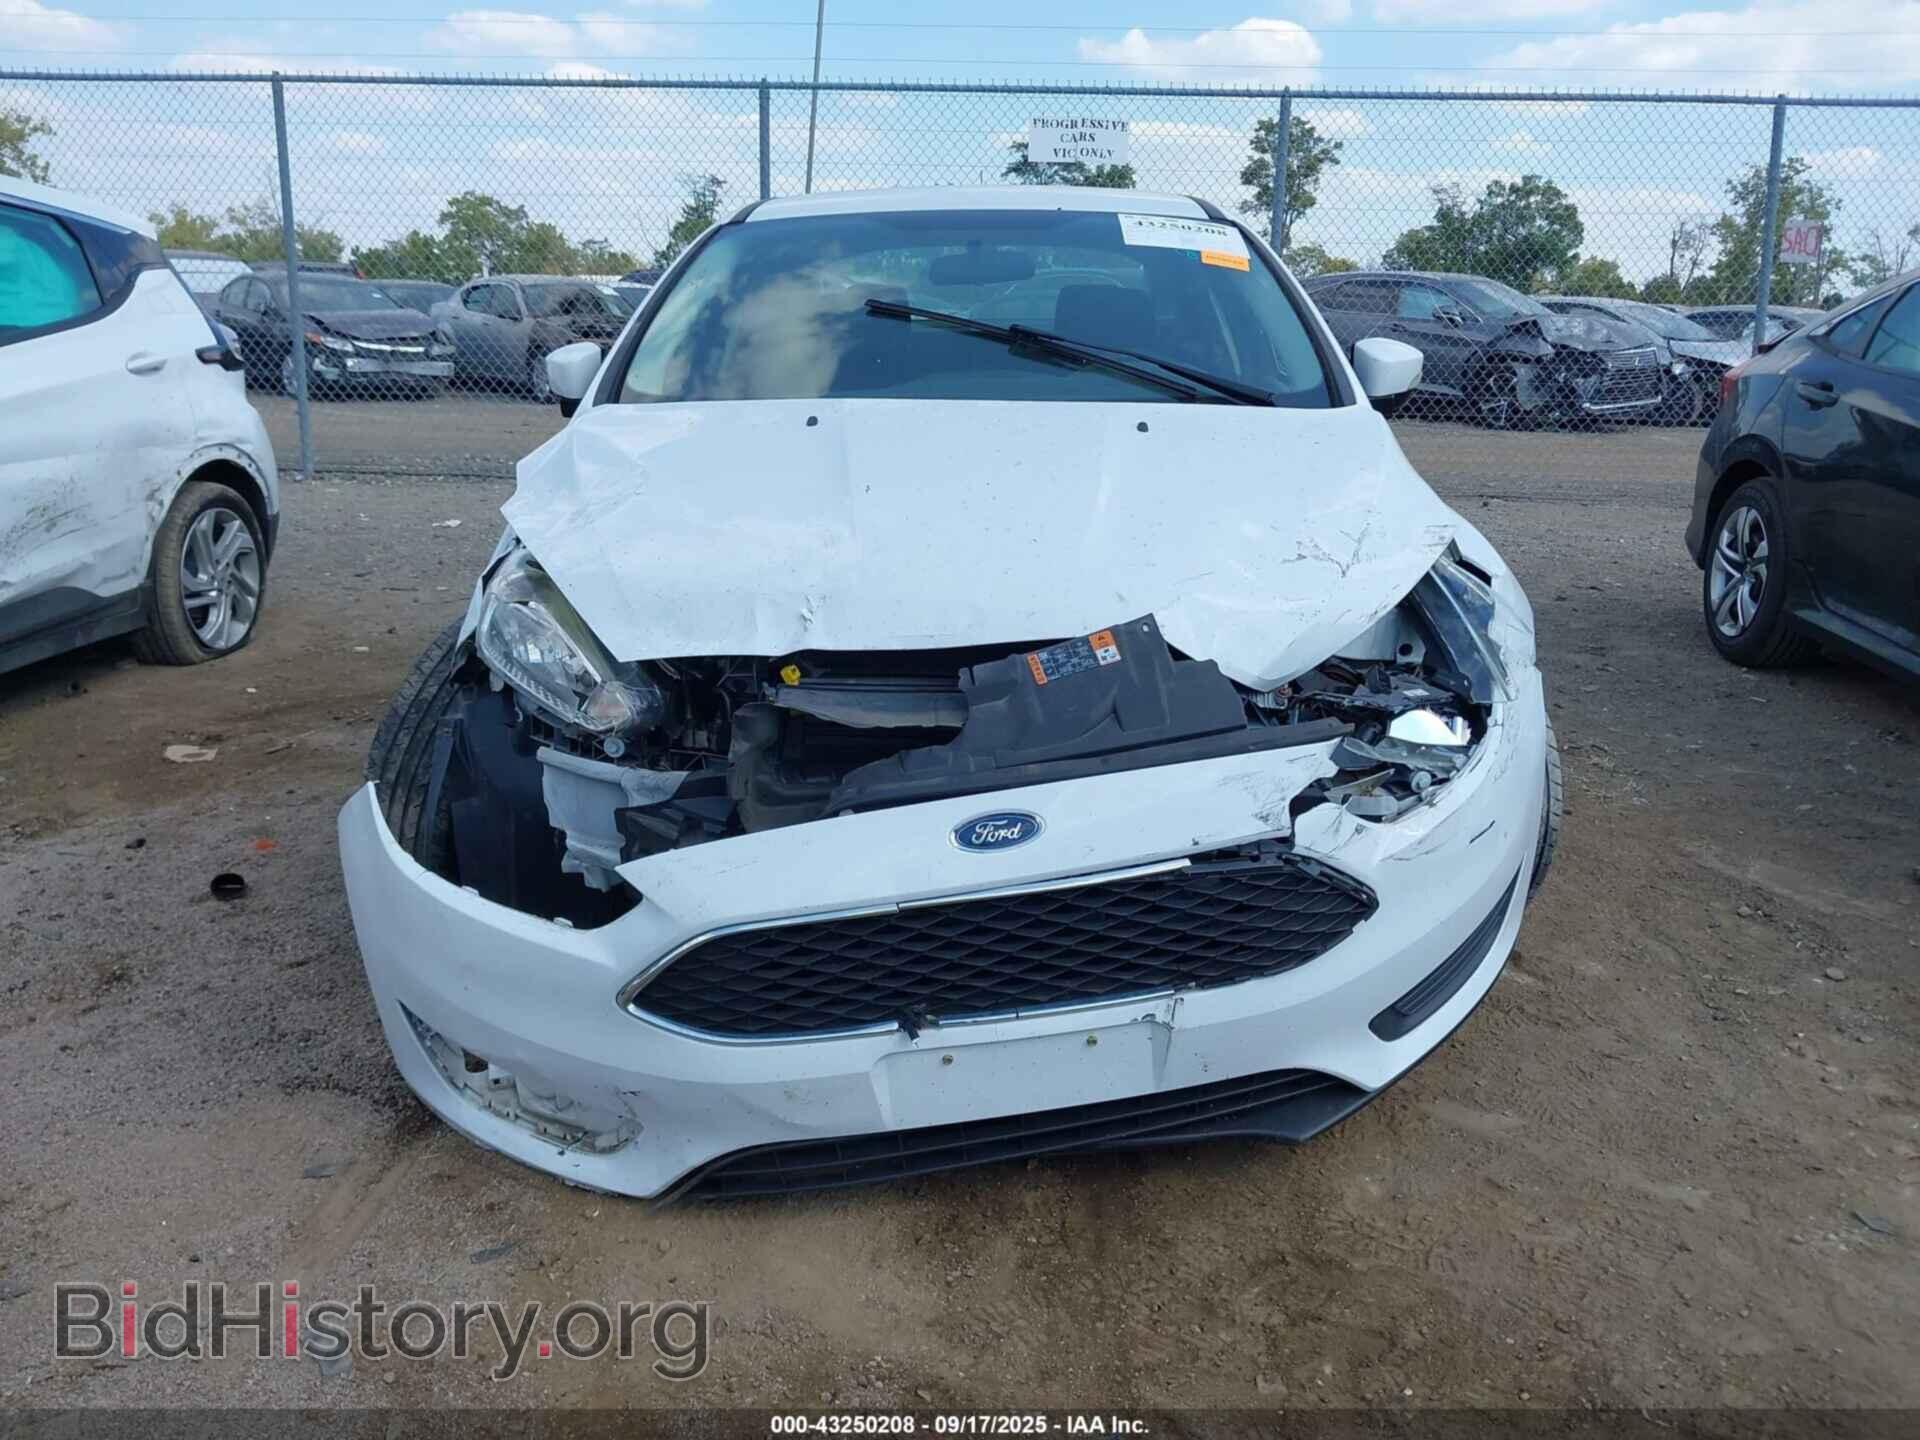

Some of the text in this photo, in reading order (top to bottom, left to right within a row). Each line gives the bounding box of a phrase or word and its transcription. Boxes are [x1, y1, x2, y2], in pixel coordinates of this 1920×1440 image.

[1032, 118, 1128, 132] PROGRESSIVE
[1060, 131, 1096, 143] CARS
[971, 819, 1022, 844] Ford
